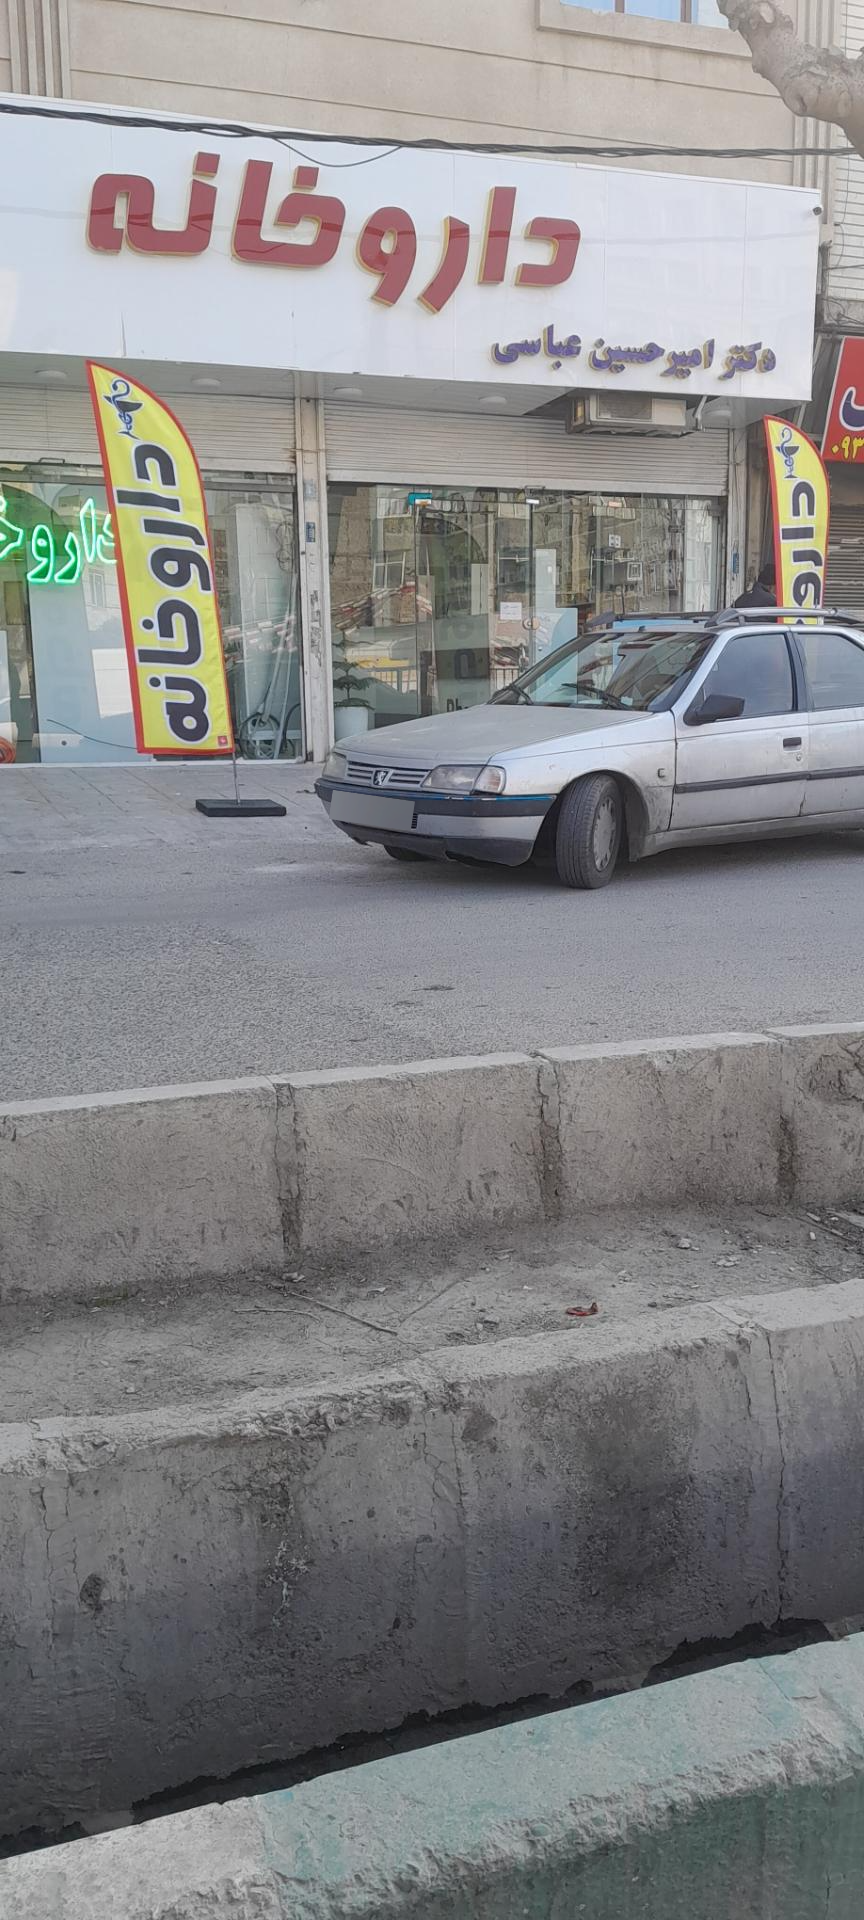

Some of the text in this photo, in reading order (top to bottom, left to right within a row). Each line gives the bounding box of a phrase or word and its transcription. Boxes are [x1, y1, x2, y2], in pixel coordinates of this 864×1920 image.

[87, 152, 582, 312] داروخانه
[491, 324, 777, 380] دکتر امیر حسین عباسی
[116, 443, 212, 743] داروخانه
